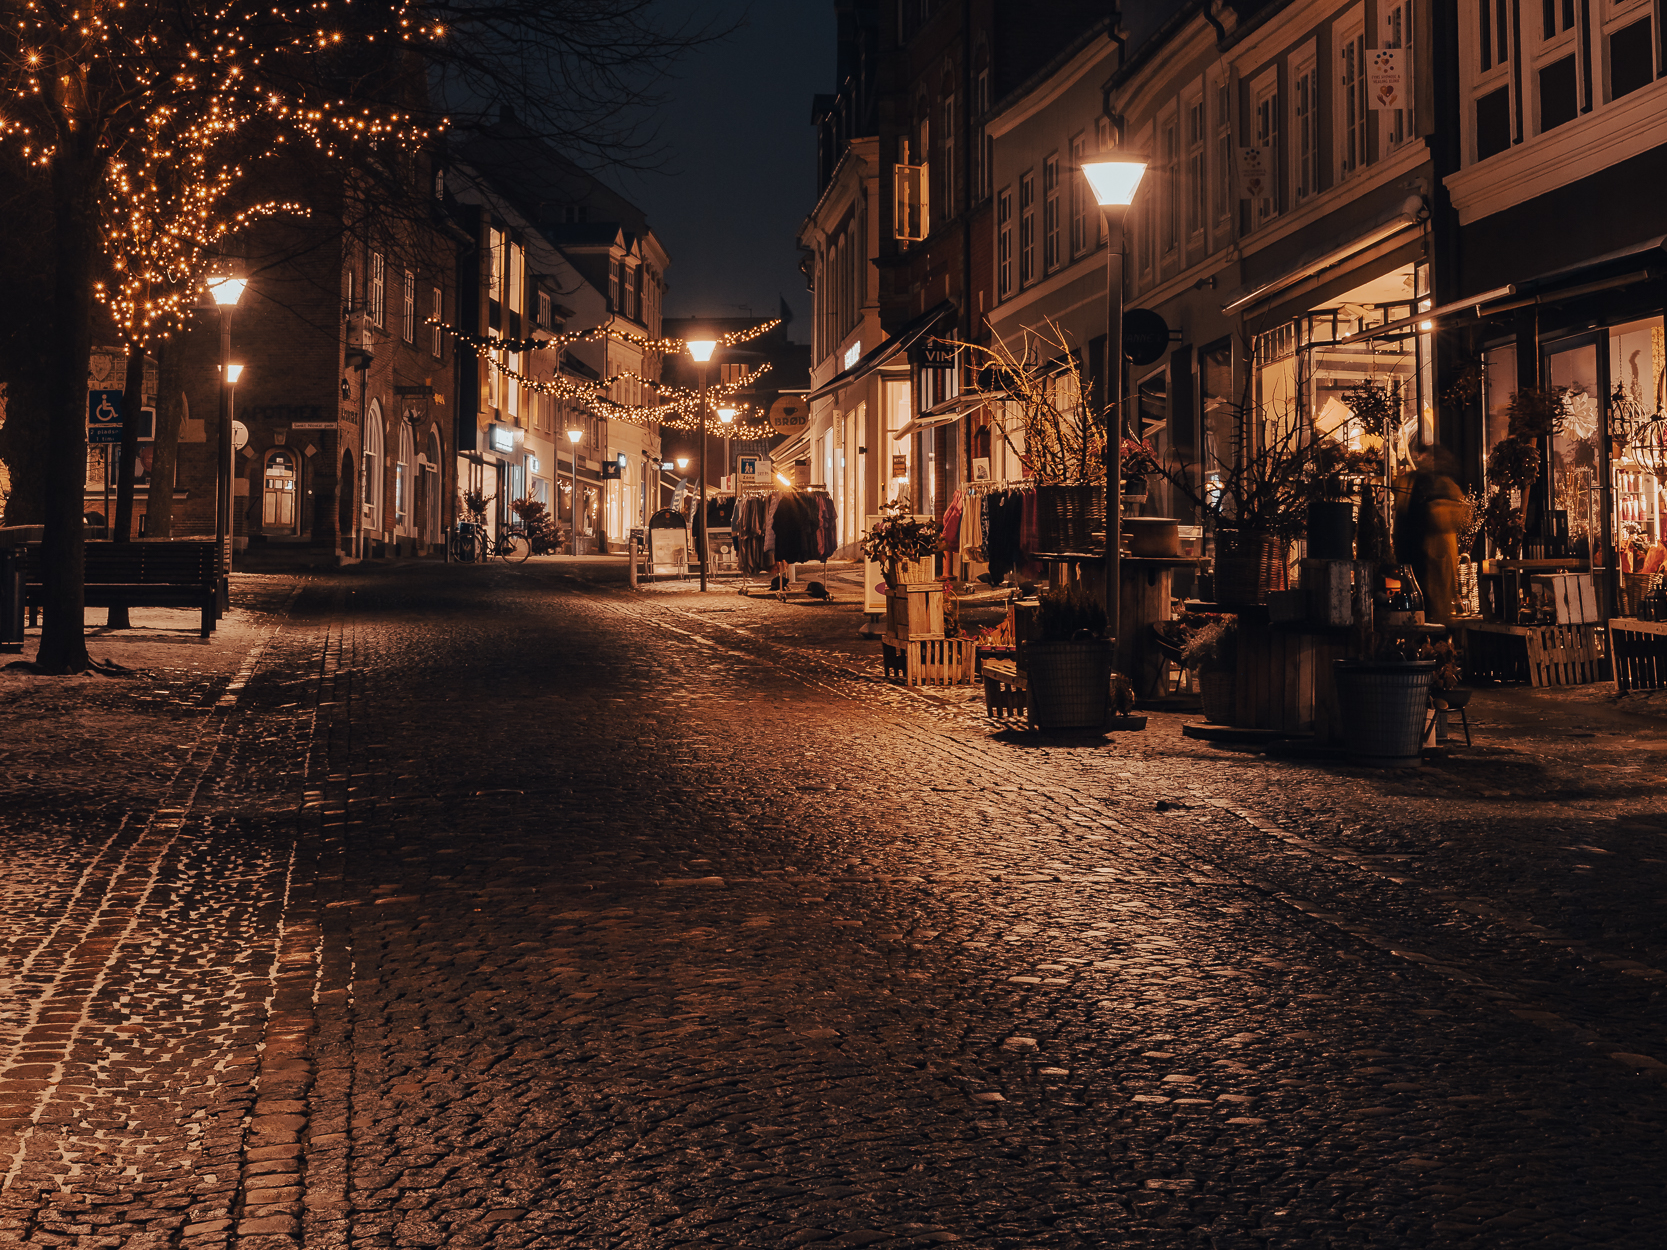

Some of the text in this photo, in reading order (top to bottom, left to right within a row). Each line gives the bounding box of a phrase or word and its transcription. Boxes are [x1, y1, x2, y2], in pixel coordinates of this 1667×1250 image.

[925, 350, 952, 362] VIN
[239, 404, 323, 421] APOTHEK
[774, 416, 806, 426] BRØD
